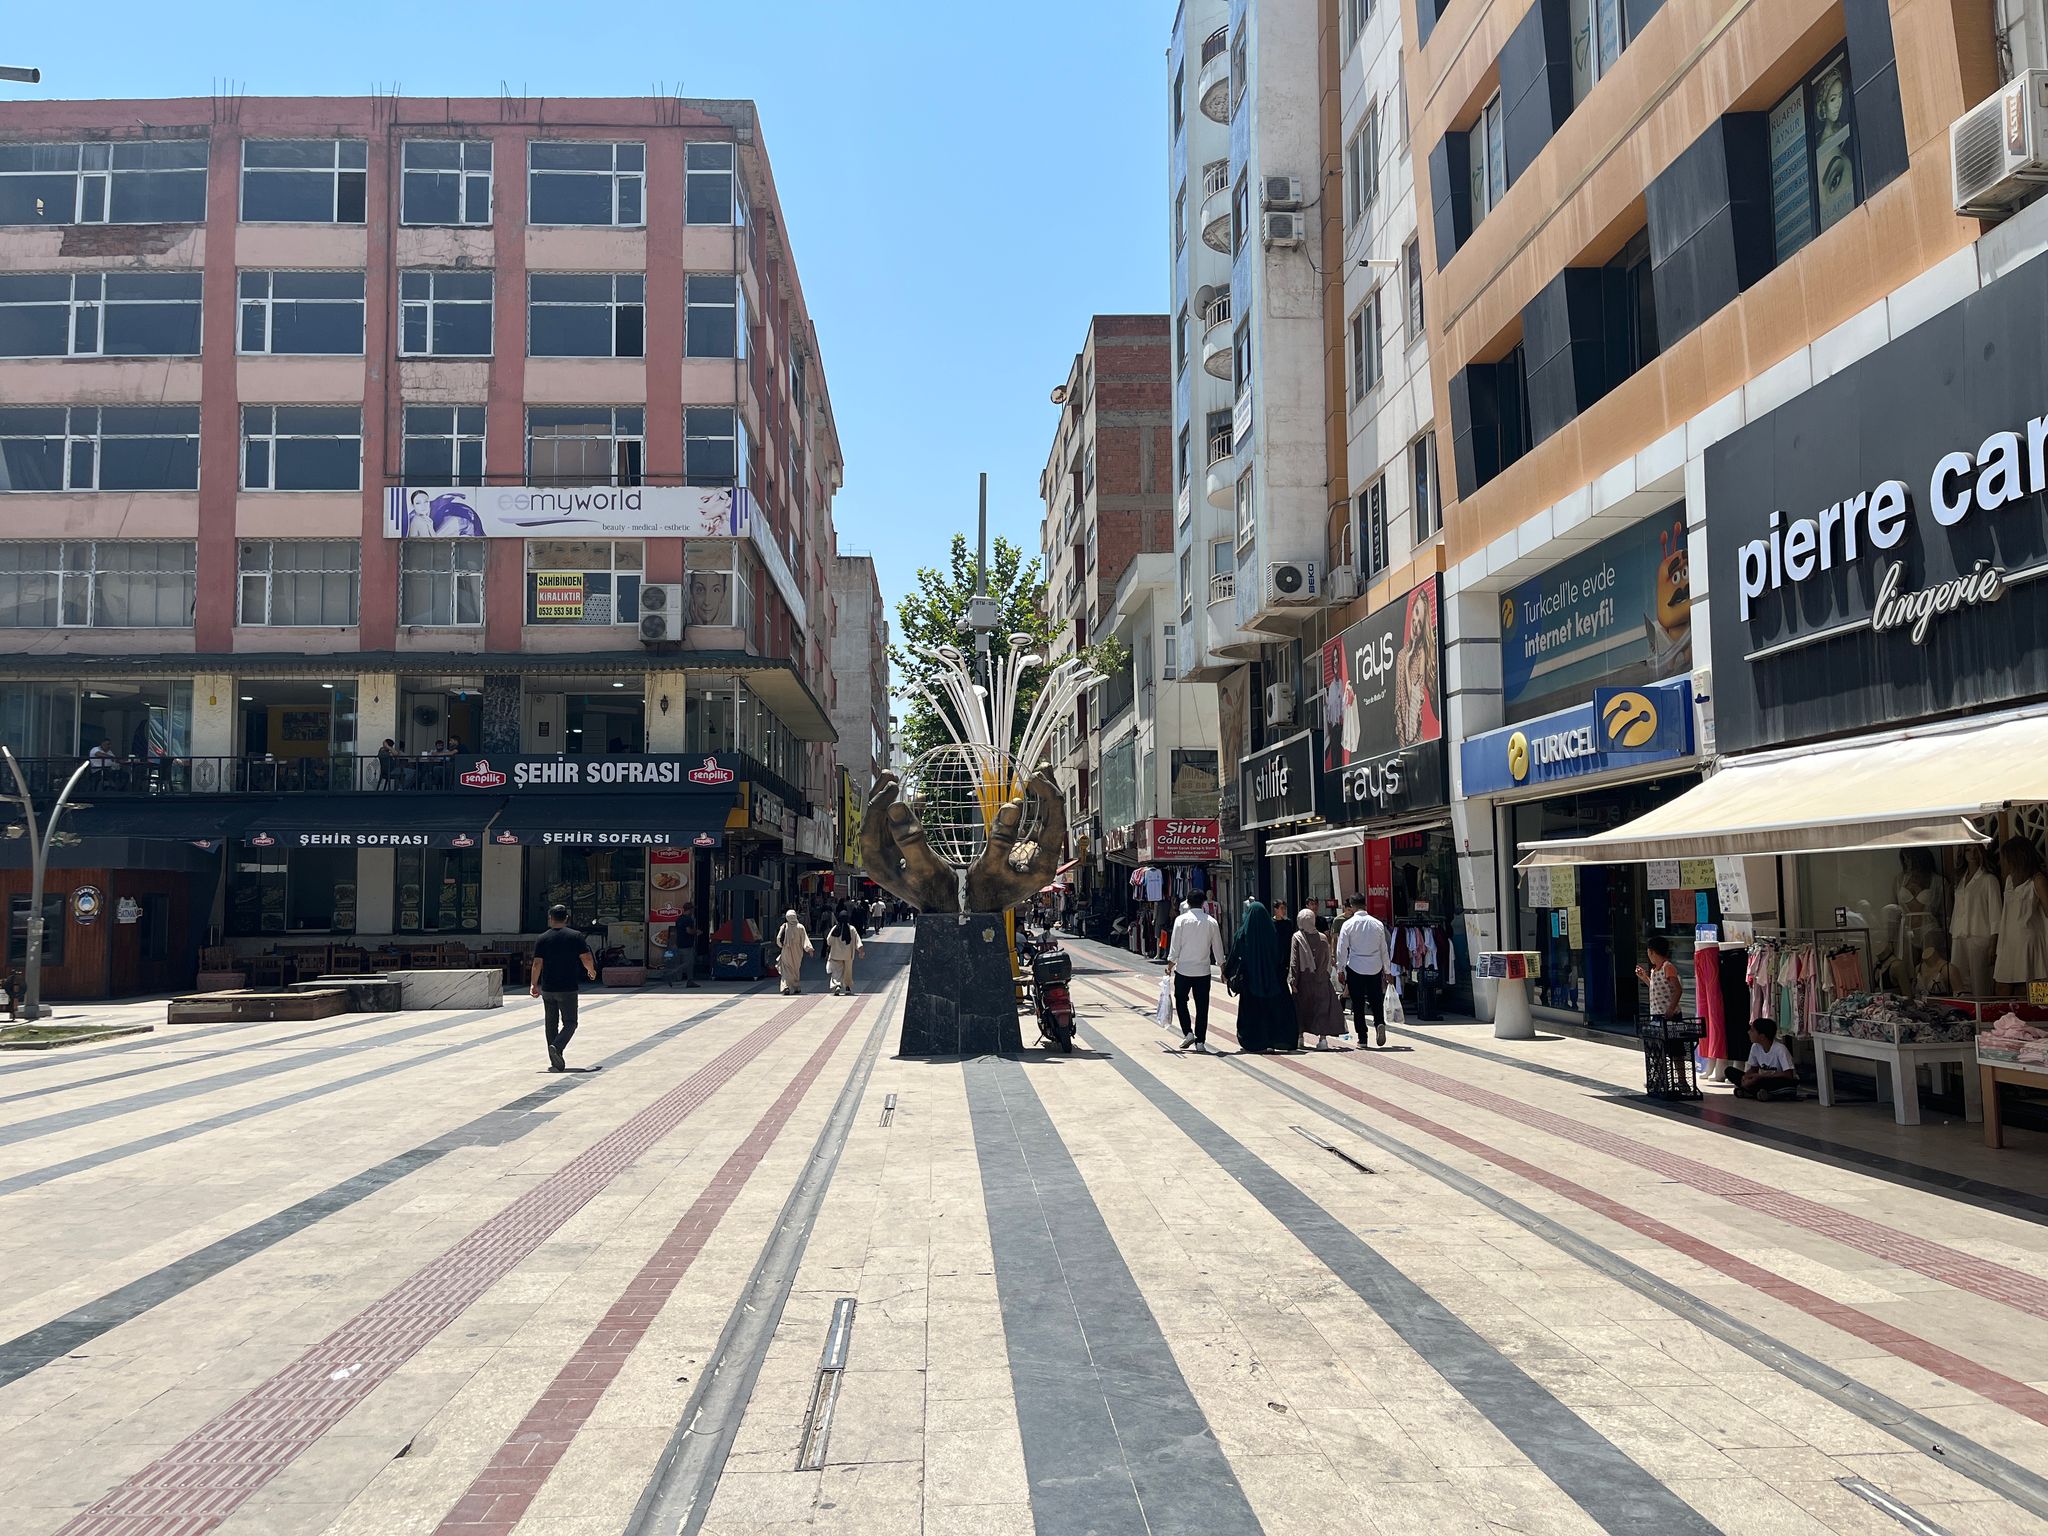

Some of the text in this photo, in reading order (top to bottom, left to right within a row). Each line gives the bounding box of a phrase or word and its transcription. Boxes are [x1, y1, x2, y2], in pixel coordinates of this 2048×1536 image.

[498, 490, 641, 515] esmyworld
[602, 523, 691, 532] beauty medical esthetic
[1738, 480, 1906, 622] pierre
[538, 574, 582, 586] SAHİBİNDEN
[1308, 563, 1316, 593] BEKO
[540, 592, 581, 601] KIRALIKTIR
[1524, 562, 1616, 624] Turkcell'le evde
[1873, 560, 2001, 645] lingerie
[539, 607, 553, 616] 0532
[1525, 598, 1614, 659] internet keyfi!
[1355, 632, 1394, 686] rays
[1531, 726, 1596, 766] TURKCEL
[465, 773, 500, 786] şenpiliç
[514, 757, 680, 789] ŞEHİR SOFRASI
[693, 770, 729, 782] şenpiliç
[1256, 754, 1289, 802] stilife
[1342, 757, 1402, 808] rays
[300, 832, 428, 847] ŞEHİR SOFRASI
[543, 831, 670, 844] ŞEHİR SOFRASI
[1166, 821, 1207, 836] Şirin
